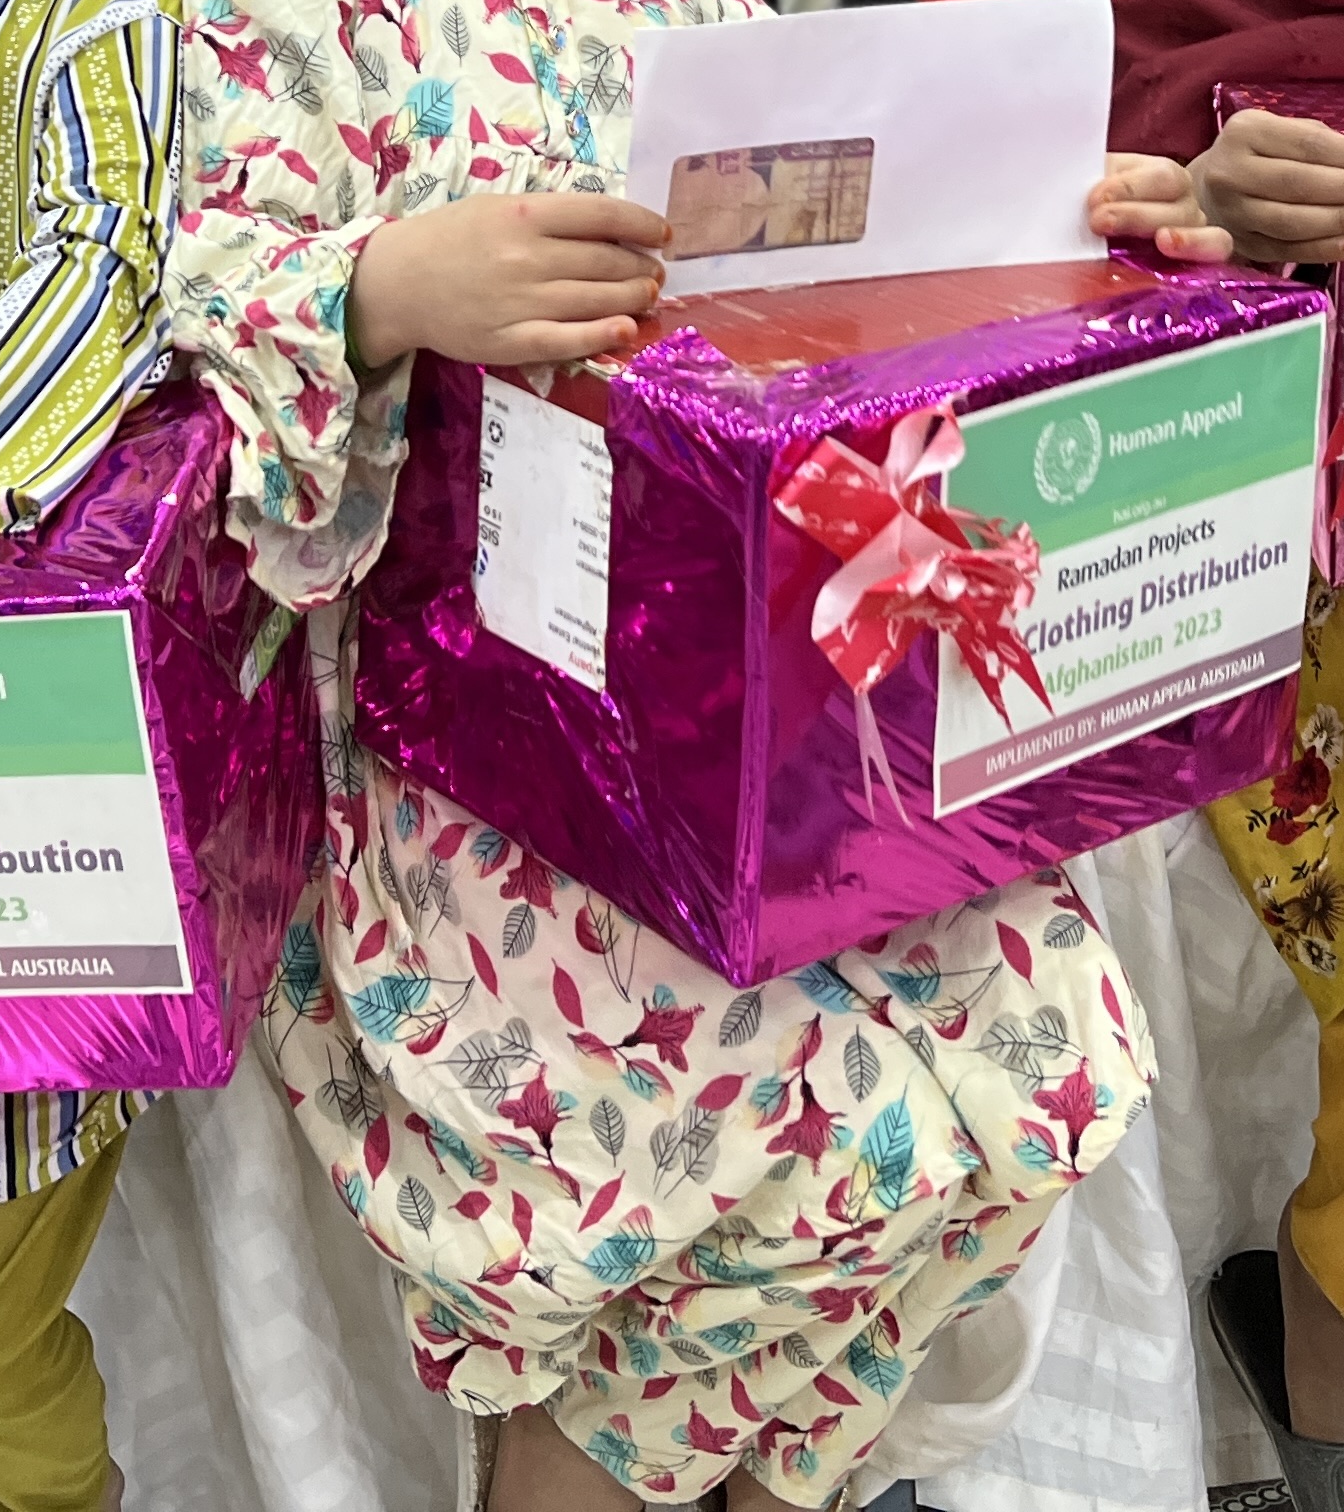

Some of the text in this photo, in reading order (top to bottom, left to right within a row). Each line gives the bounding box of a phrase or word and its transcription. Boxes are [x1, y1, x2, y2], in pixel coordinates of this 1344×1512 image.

[1108, 418, 1177, 458] Human
[1180, 391, 1244, 437] Appeal
[1056, 518, 1216, 592] Ramadan Projects
[1023, 539, 1289, 657] Clothing Distribution
[1043, 607, 1223, 697] Afghanistan 2023
[985, 650, 1266, 777] IMPLEMENTED BY: HUMAN APPEAL AUSTRALIA
[10, 955, 115, 978] AUSTRALIA
